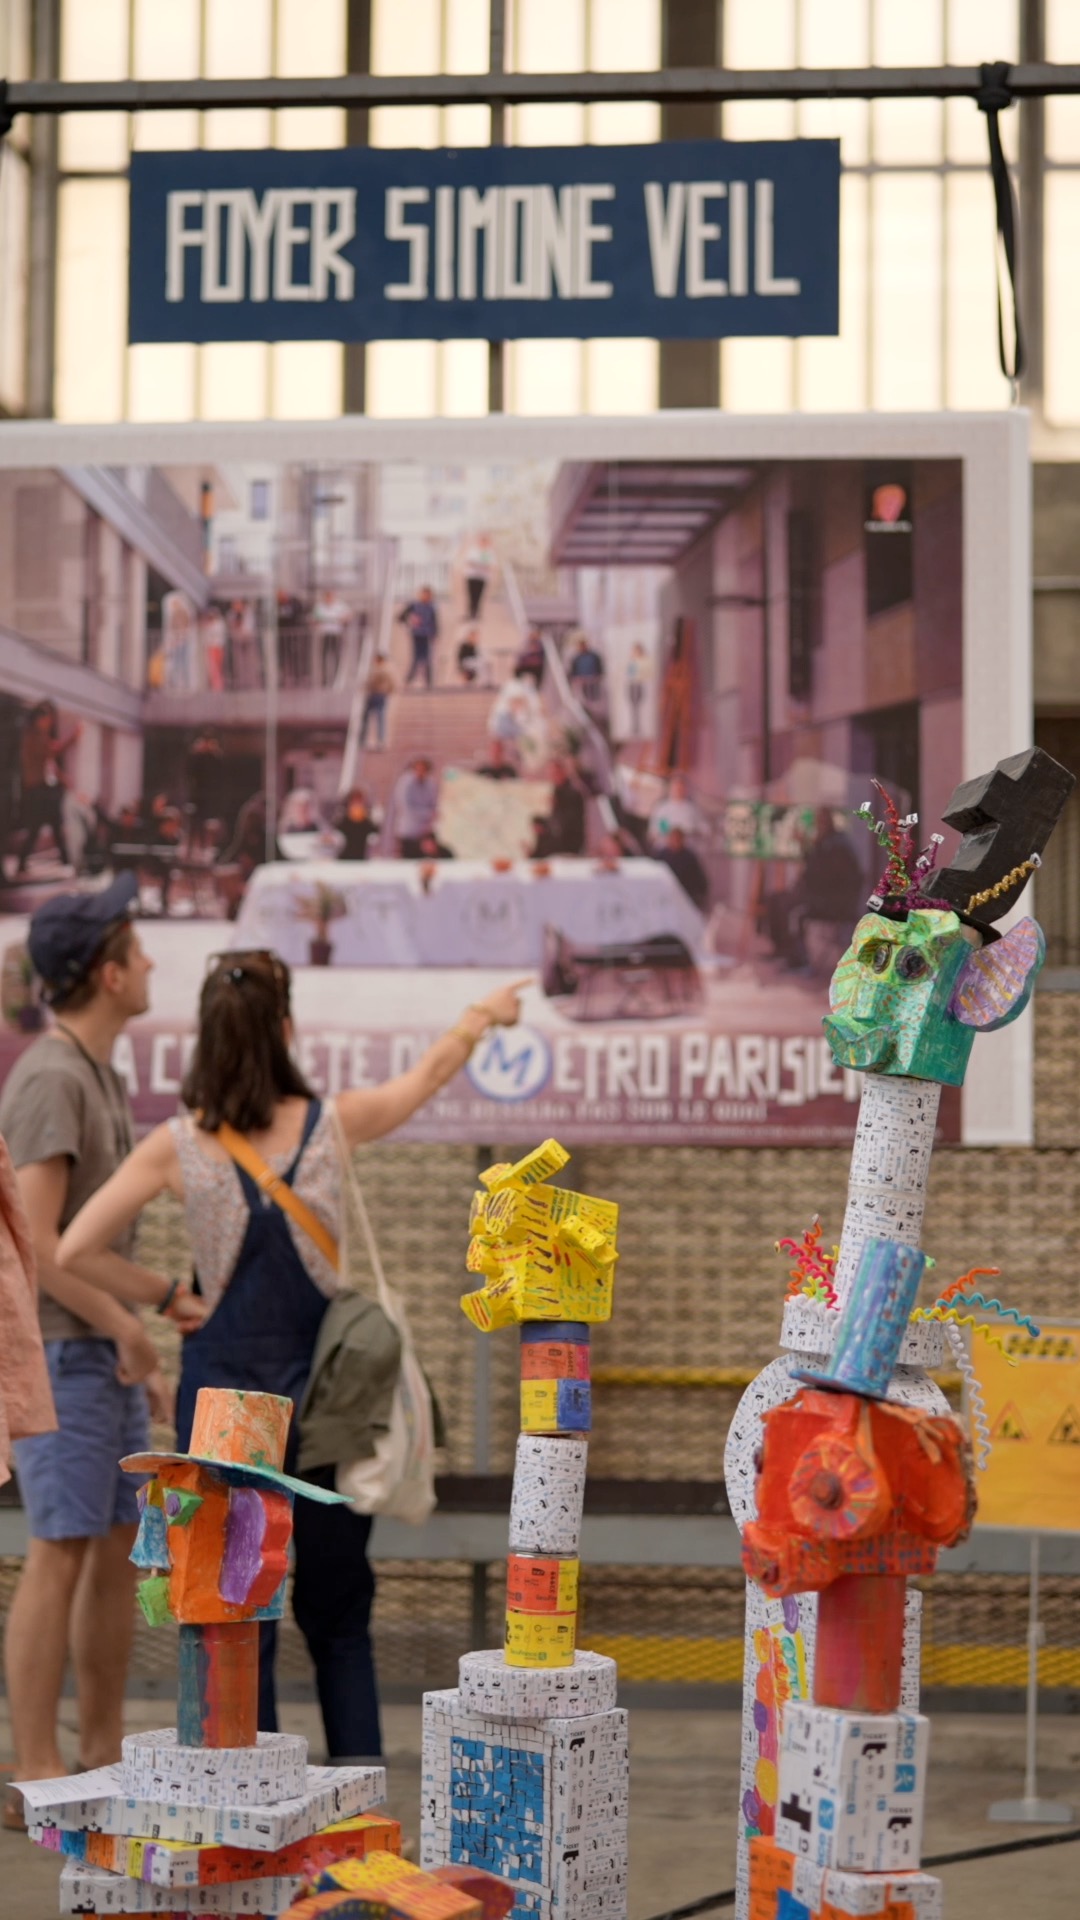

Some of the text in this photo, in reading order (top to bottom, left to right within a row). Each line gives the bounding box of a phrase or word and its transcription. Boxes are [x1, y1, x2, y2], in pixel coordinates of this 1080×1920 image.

[166, 180, 800, 302] FOYER SIMONE VEIL
